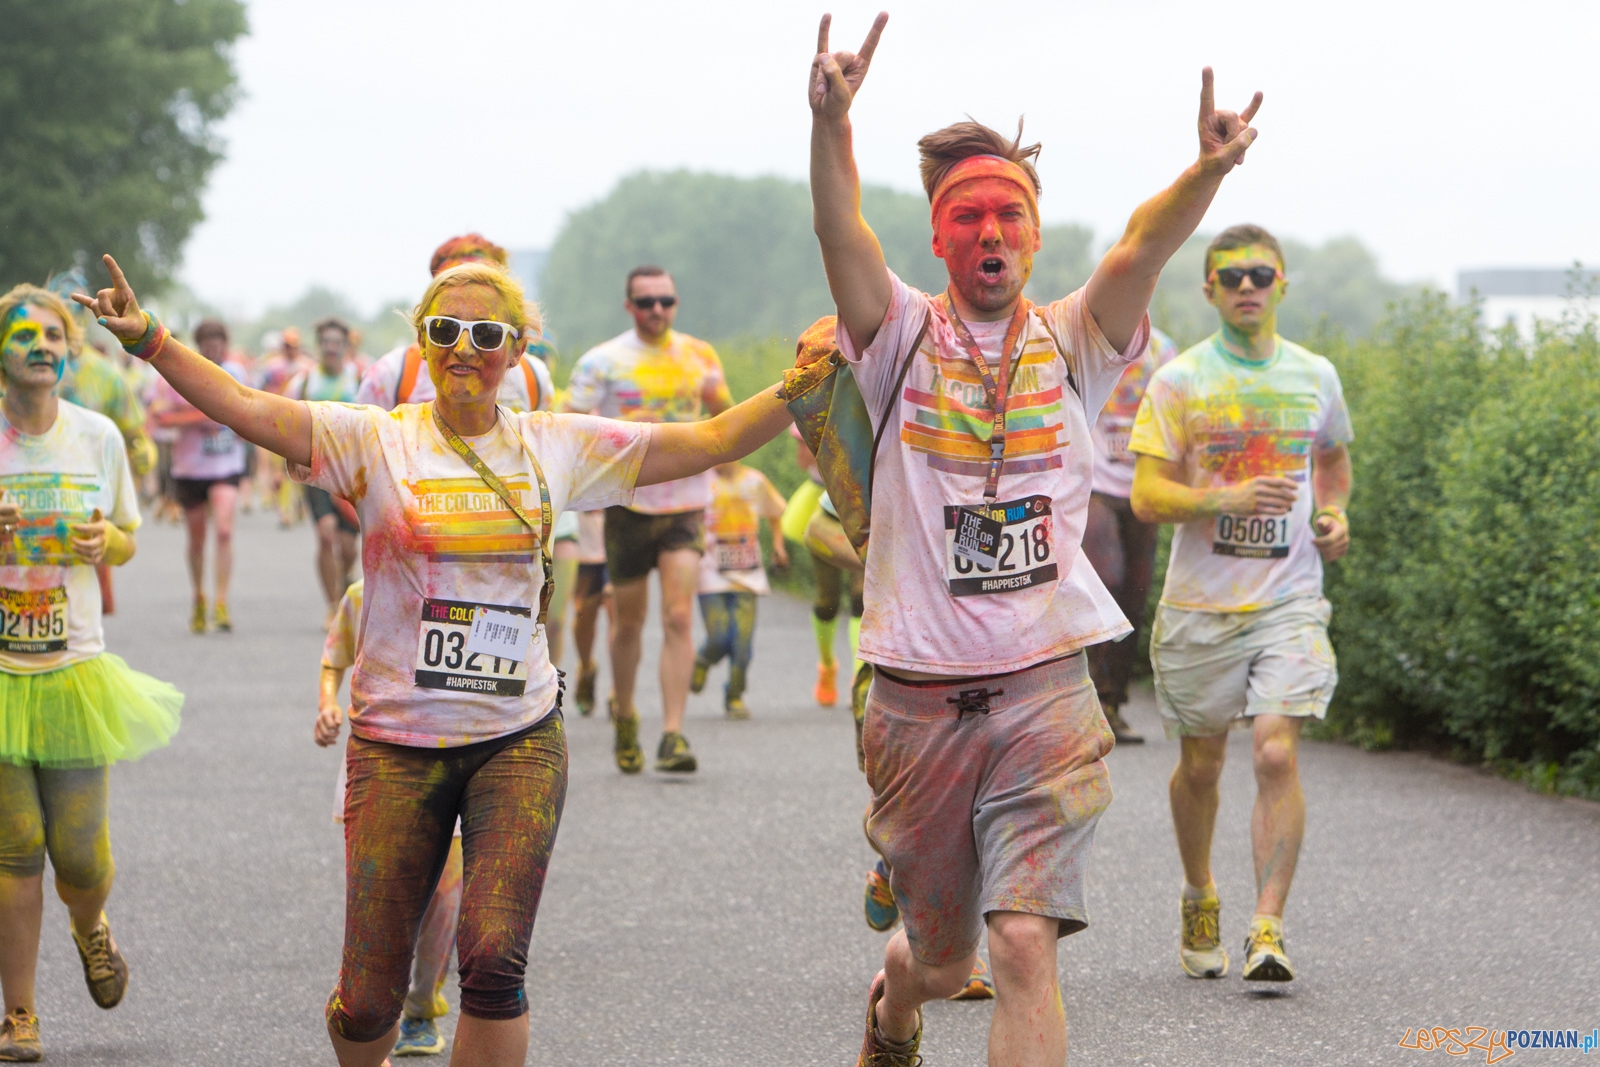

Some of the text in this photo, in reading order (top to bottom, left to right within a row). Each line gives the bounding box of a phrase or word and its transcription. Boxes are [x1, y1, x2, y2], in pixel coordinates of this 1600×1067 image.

[974, 355, 990, 377] COLOR
[449, 435, 471, 456] COLOR
[416, 488, 523, 513] THE COLOR RN
[542, 502, 552, 525] COLOR
[963, 512, 983, 531] THE
[960, 524, 994, 547] COLOR
[1218, 513, 1287, 544] 05081
[954, 523, 1050, 575] 218
[958, 534, 981, 552] RUN
[982, 573, 1032, 591] #HAPPIEST5K
[430, 604, 476, 623] THE COLO
[446, 676, 498, 692] #HAPPIEST5K
